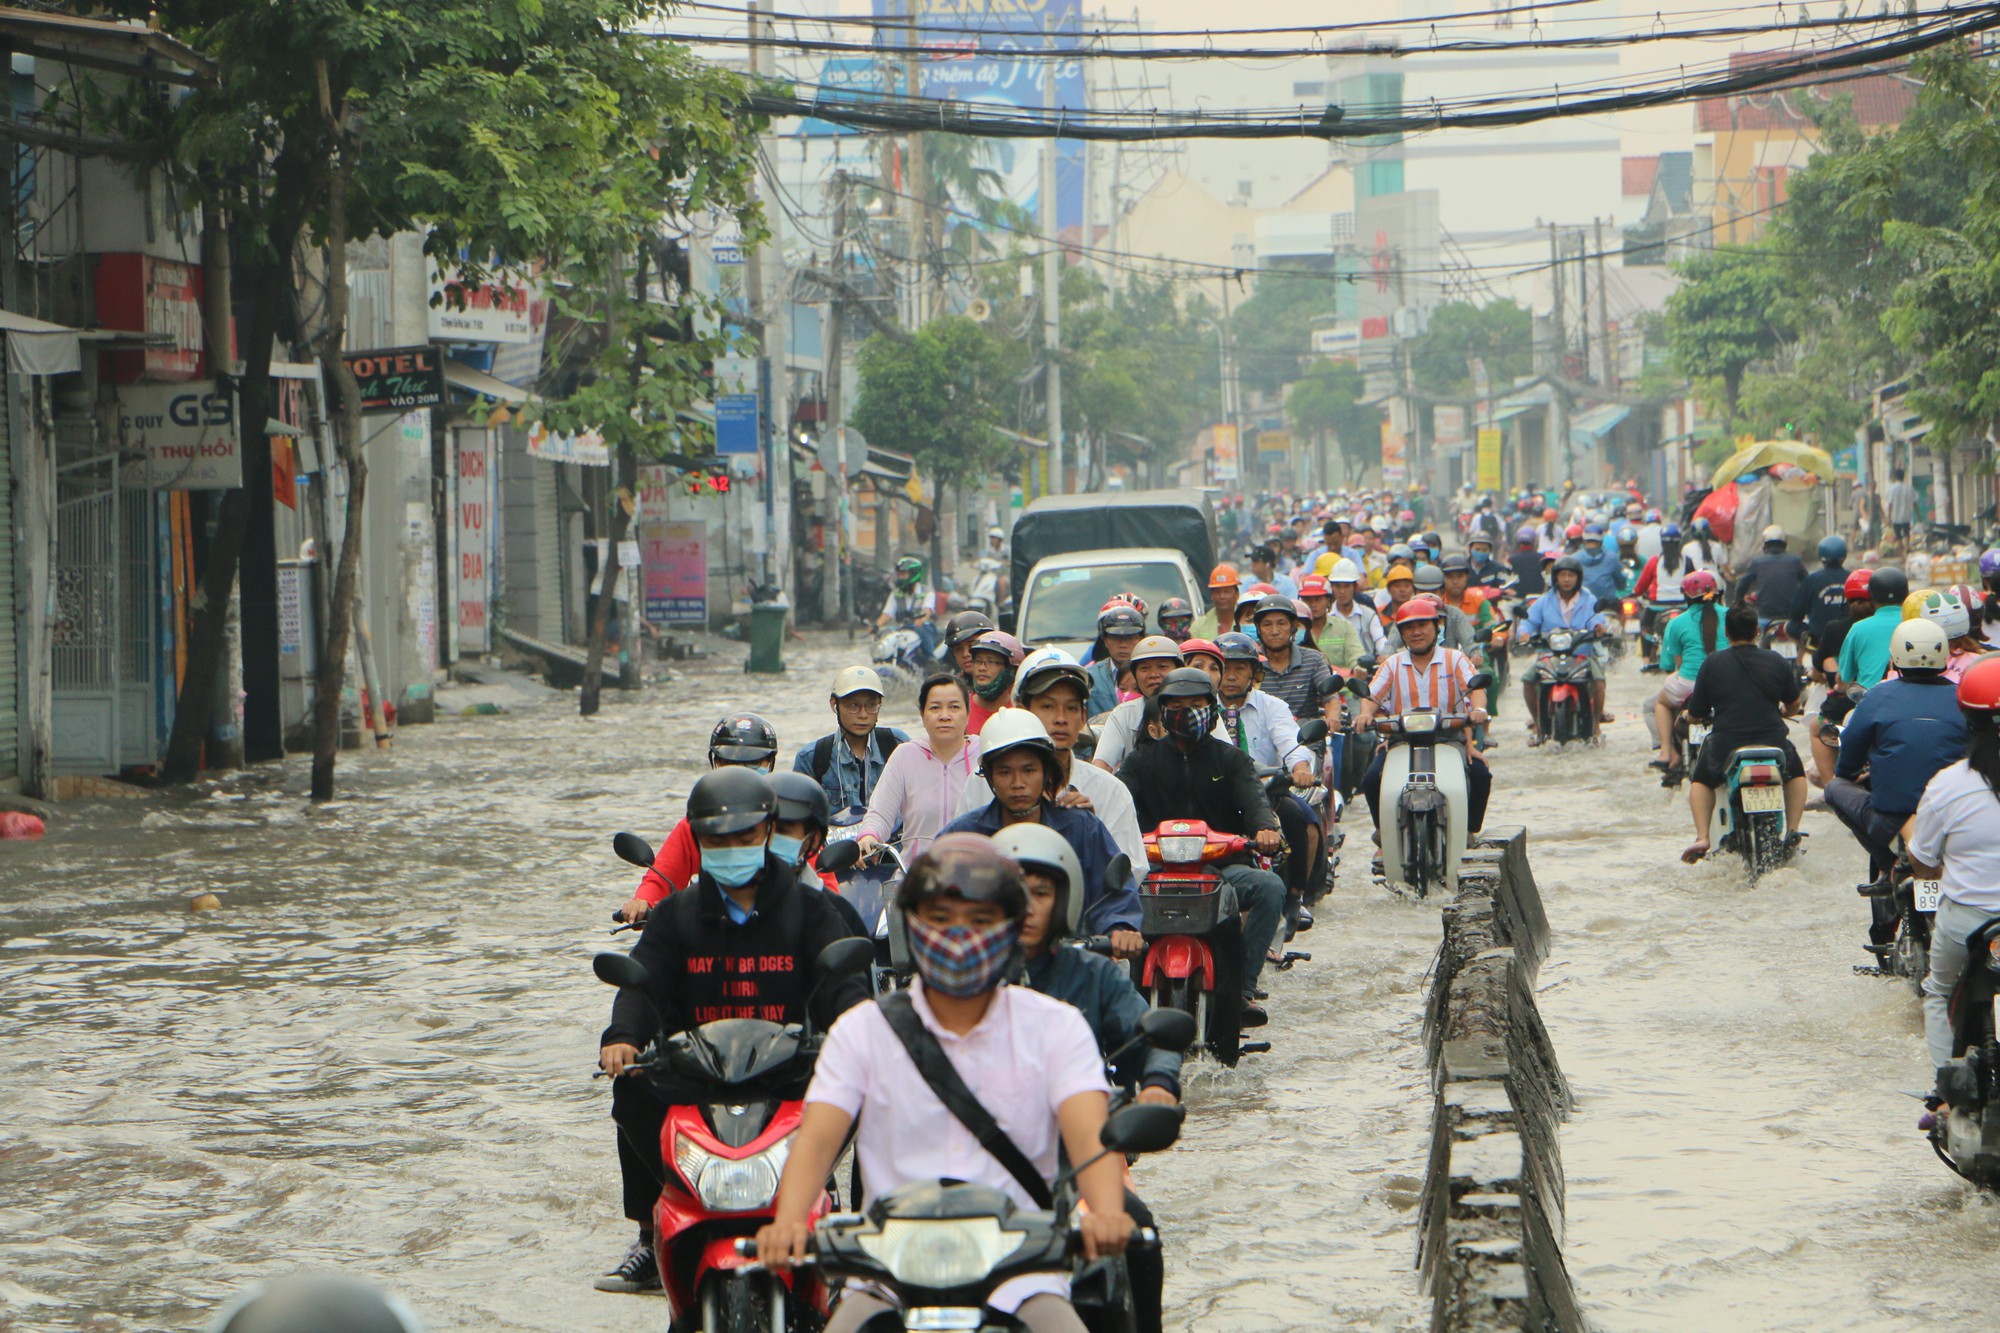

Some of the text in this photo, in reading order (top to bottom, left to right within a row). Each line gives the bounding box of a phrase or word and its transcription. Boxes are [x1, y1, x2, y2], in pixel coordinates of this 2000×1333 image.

[169, 393, 231, 427] GS
[417, 393, 440, 405] 20M
[135, 415, 164, 430] QUY
[160, 445, 195, 459] THU
[460, 451, 484, 484] DỊCH
[462, 503, 483, 538] VỤ
[463, 552, 483, 586] ĐỊA
[687, 956, 714, 973] MAY
[738, 955, 795, 974] BRDGES
